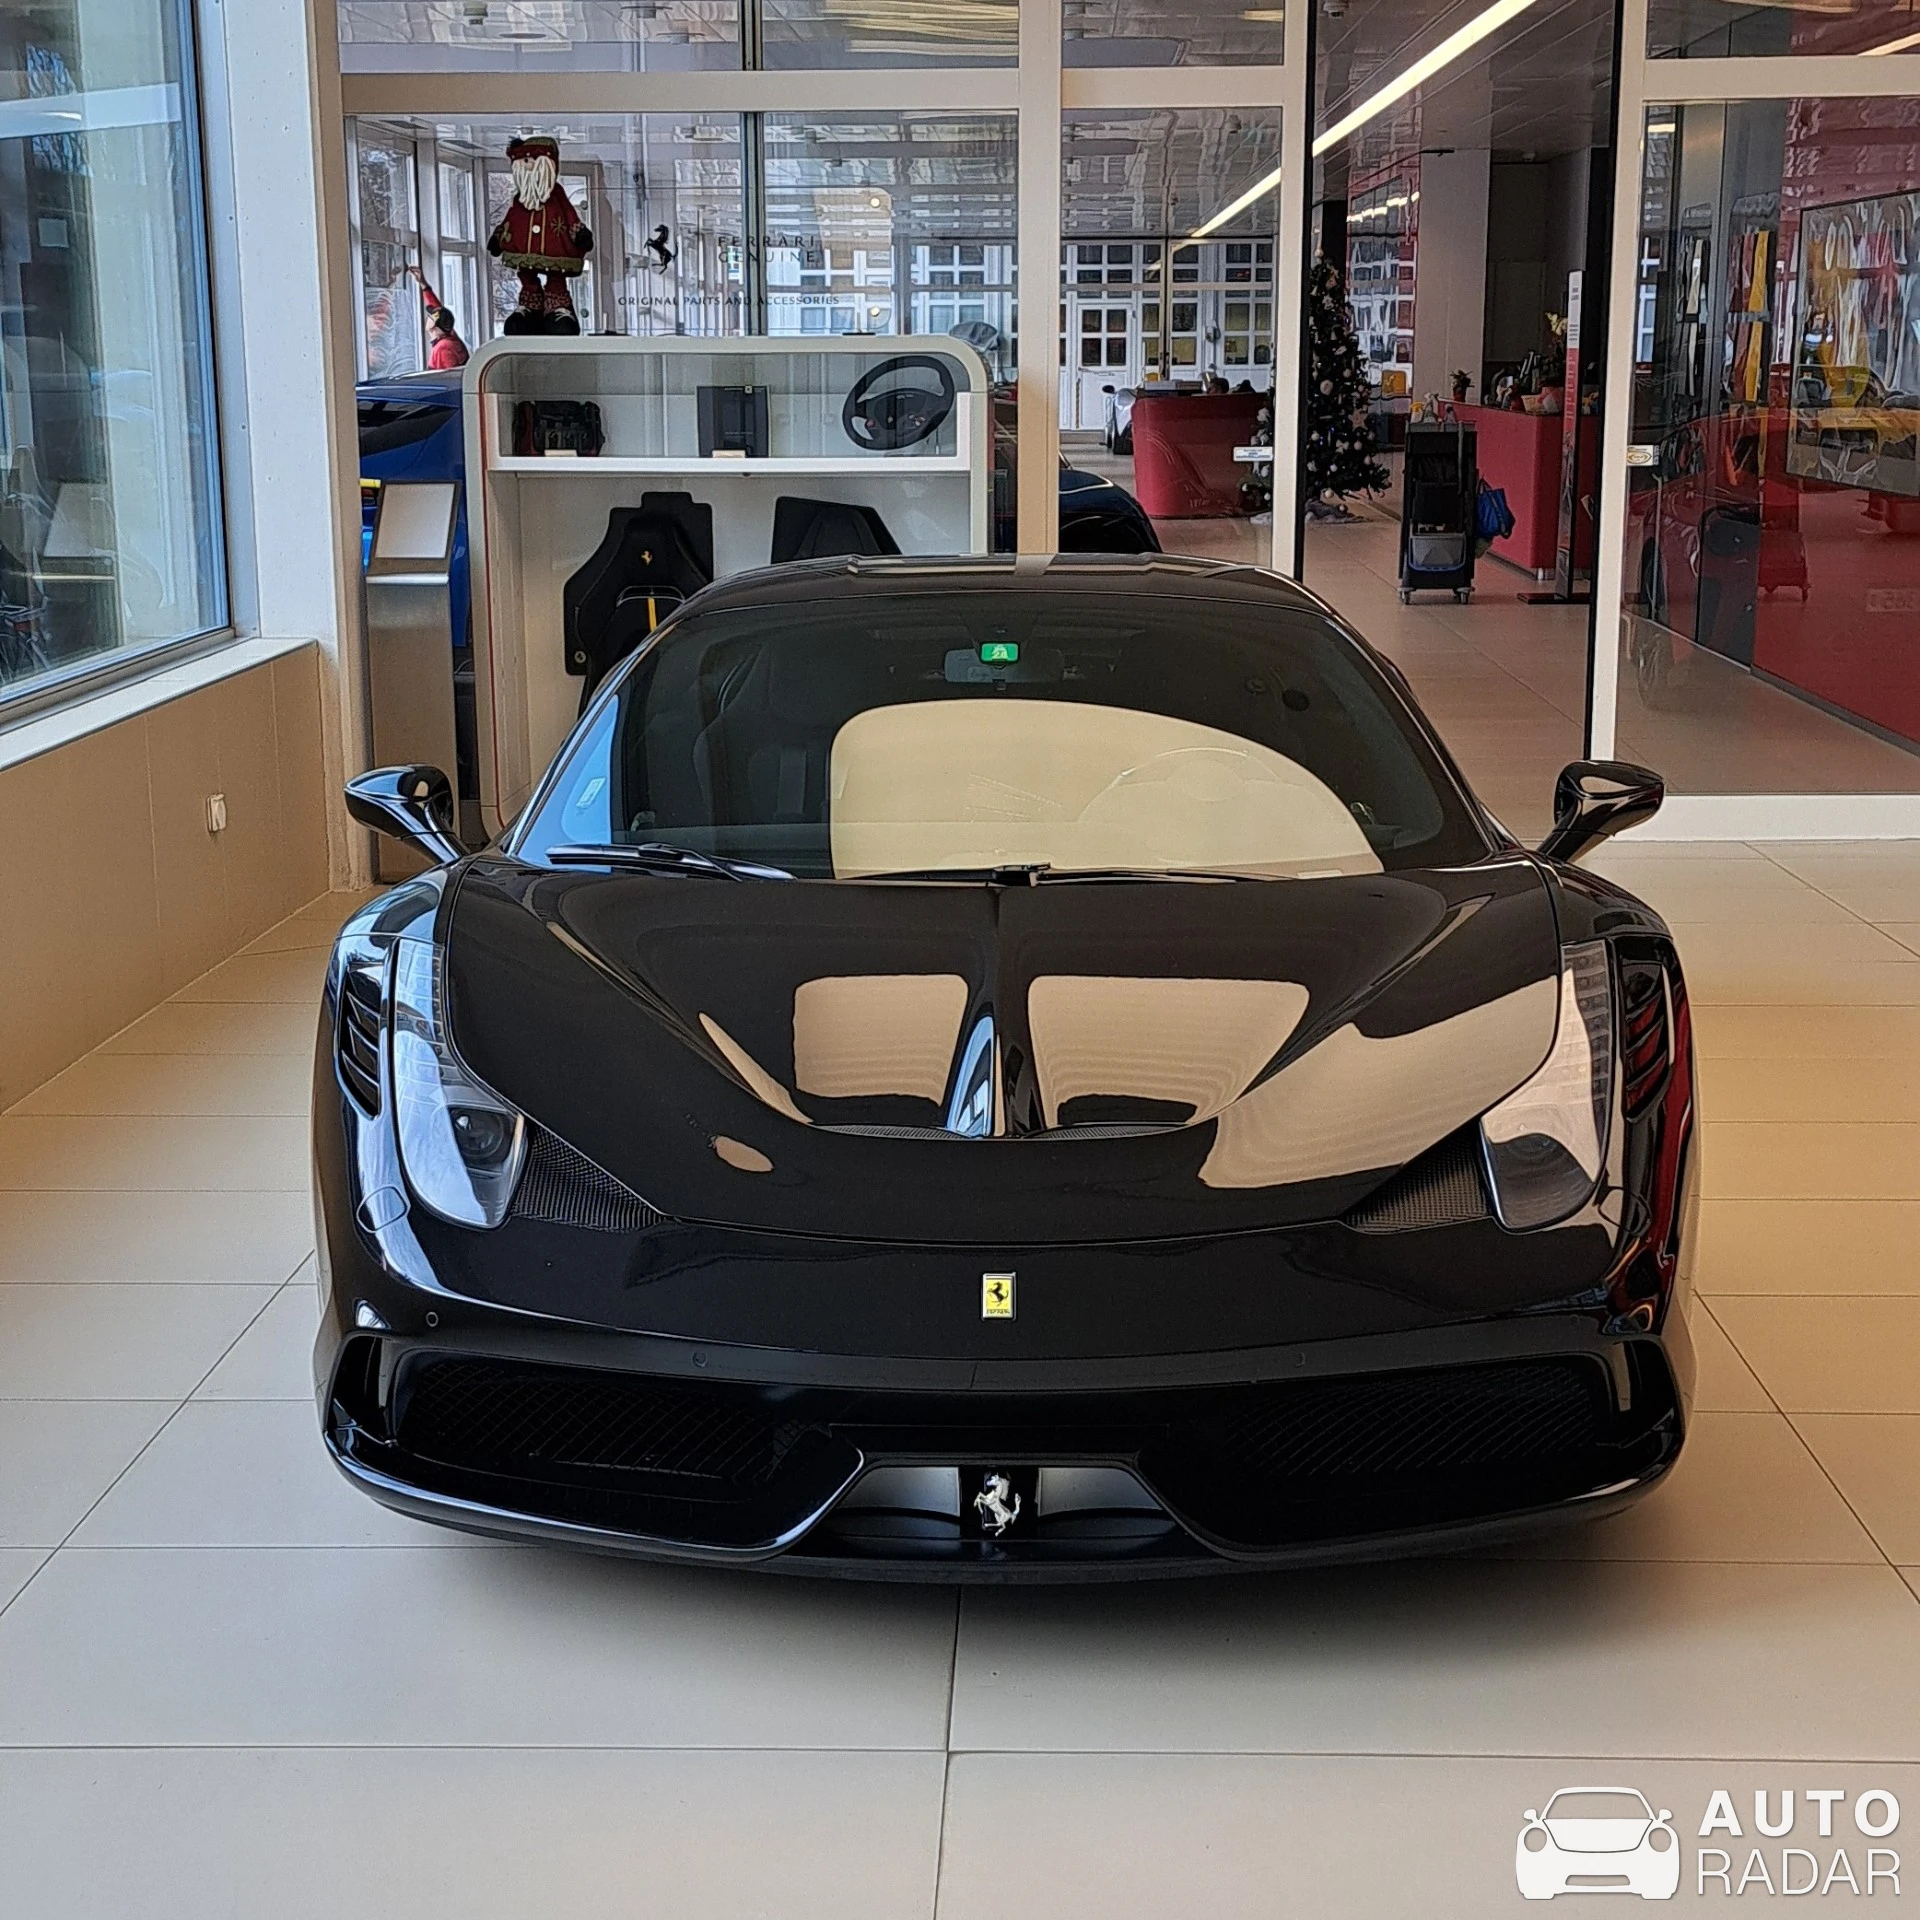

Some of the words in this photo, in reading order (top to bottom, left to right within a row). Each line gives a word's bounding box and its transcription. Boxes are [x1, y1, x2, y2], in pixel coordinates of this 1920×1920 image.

[717, 235, 815, 248] FERRARI
[717, 250, 816, 263] GENUINE
[617, 296, 679, 306] ORIGINAL
[756, 295, 840, 306] ACCESSORIES
